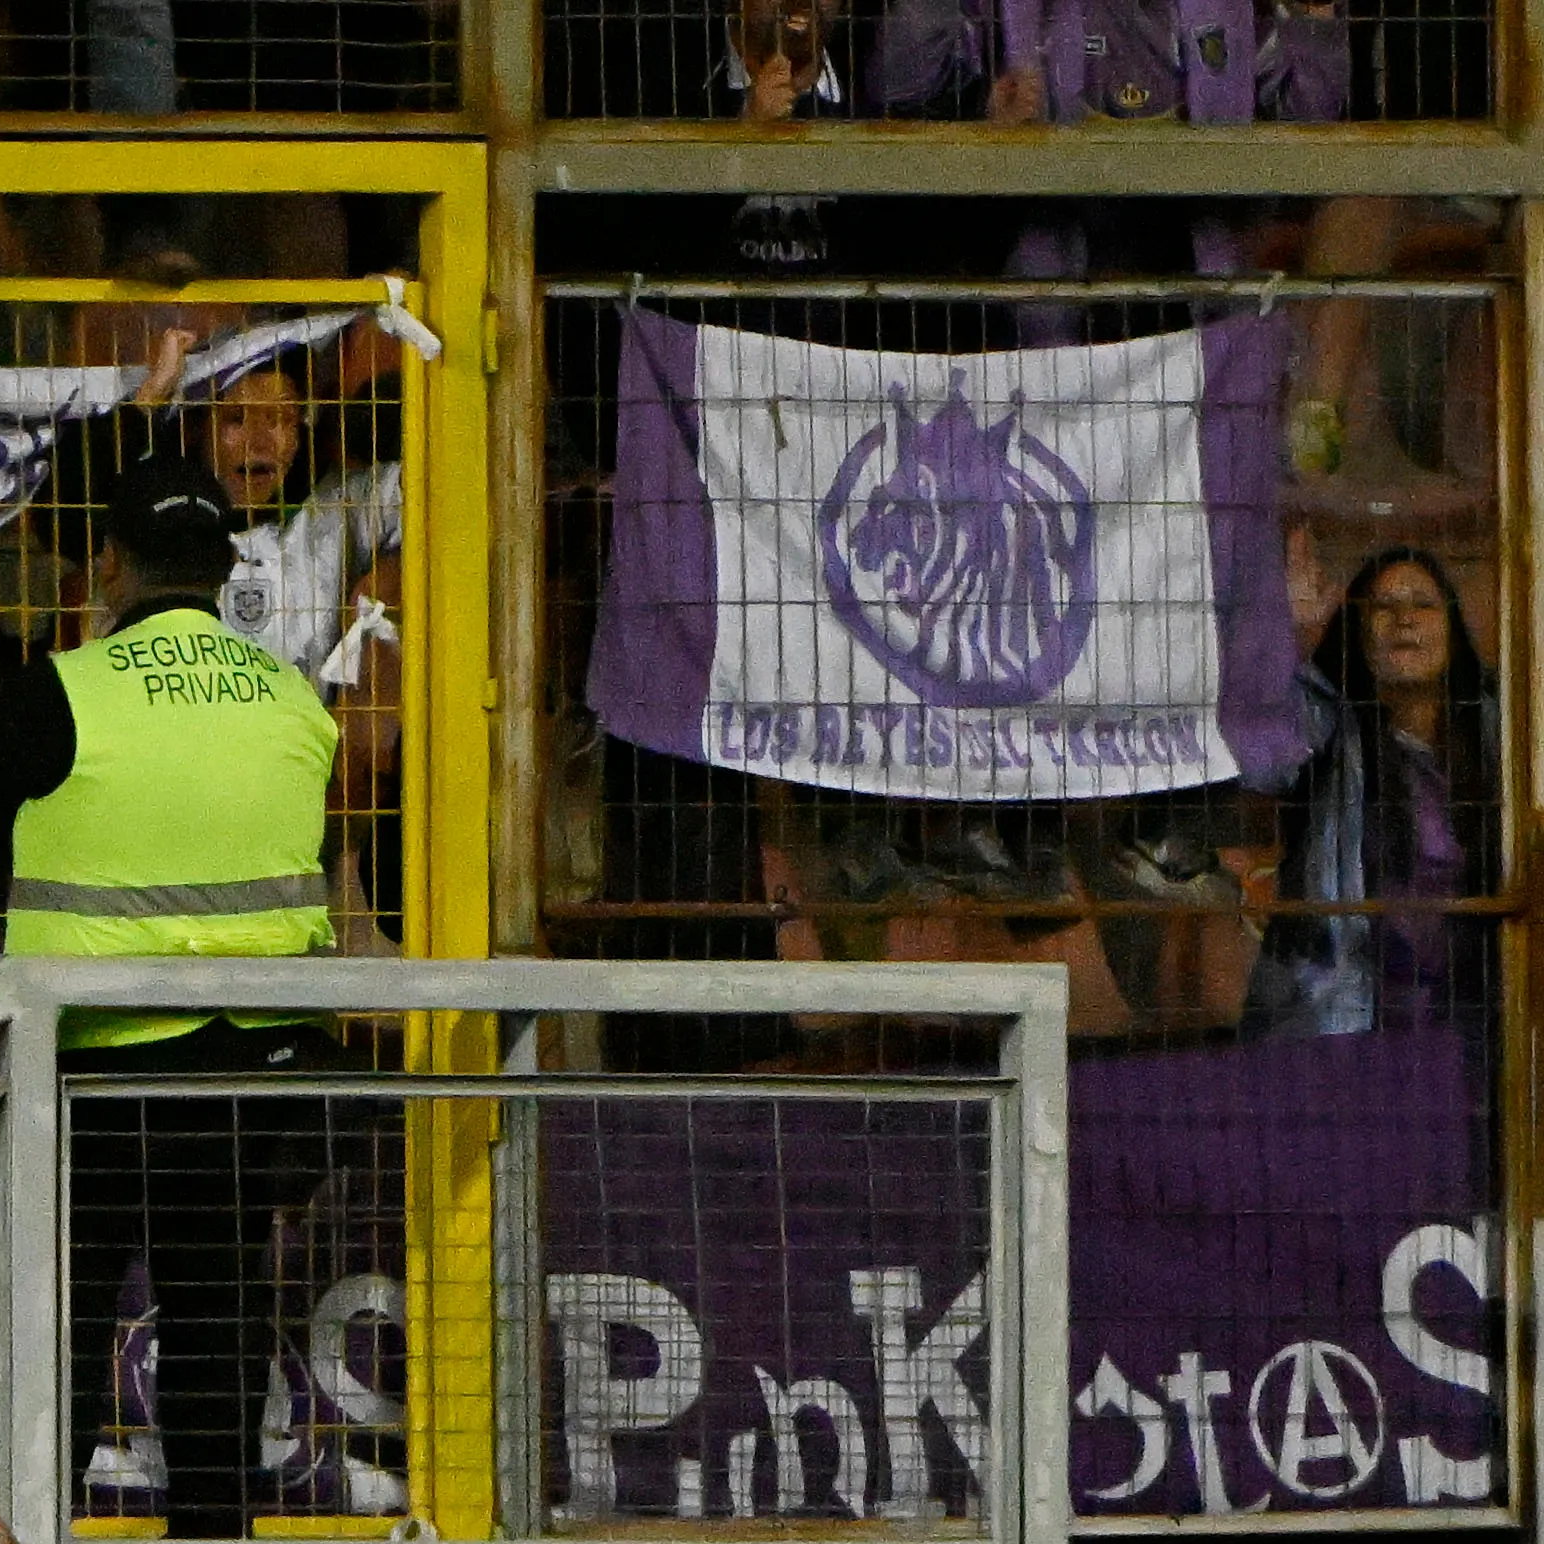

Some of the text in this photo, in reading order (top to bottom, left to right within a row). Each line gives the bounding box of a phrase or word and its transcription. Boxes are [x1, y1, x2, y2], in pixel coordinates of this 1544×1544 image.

[107, 632, 280, 673] SEGURIDAD
[143, 670, 277, 706] PRIVADA
[717, 702, 800, 763] LOS
